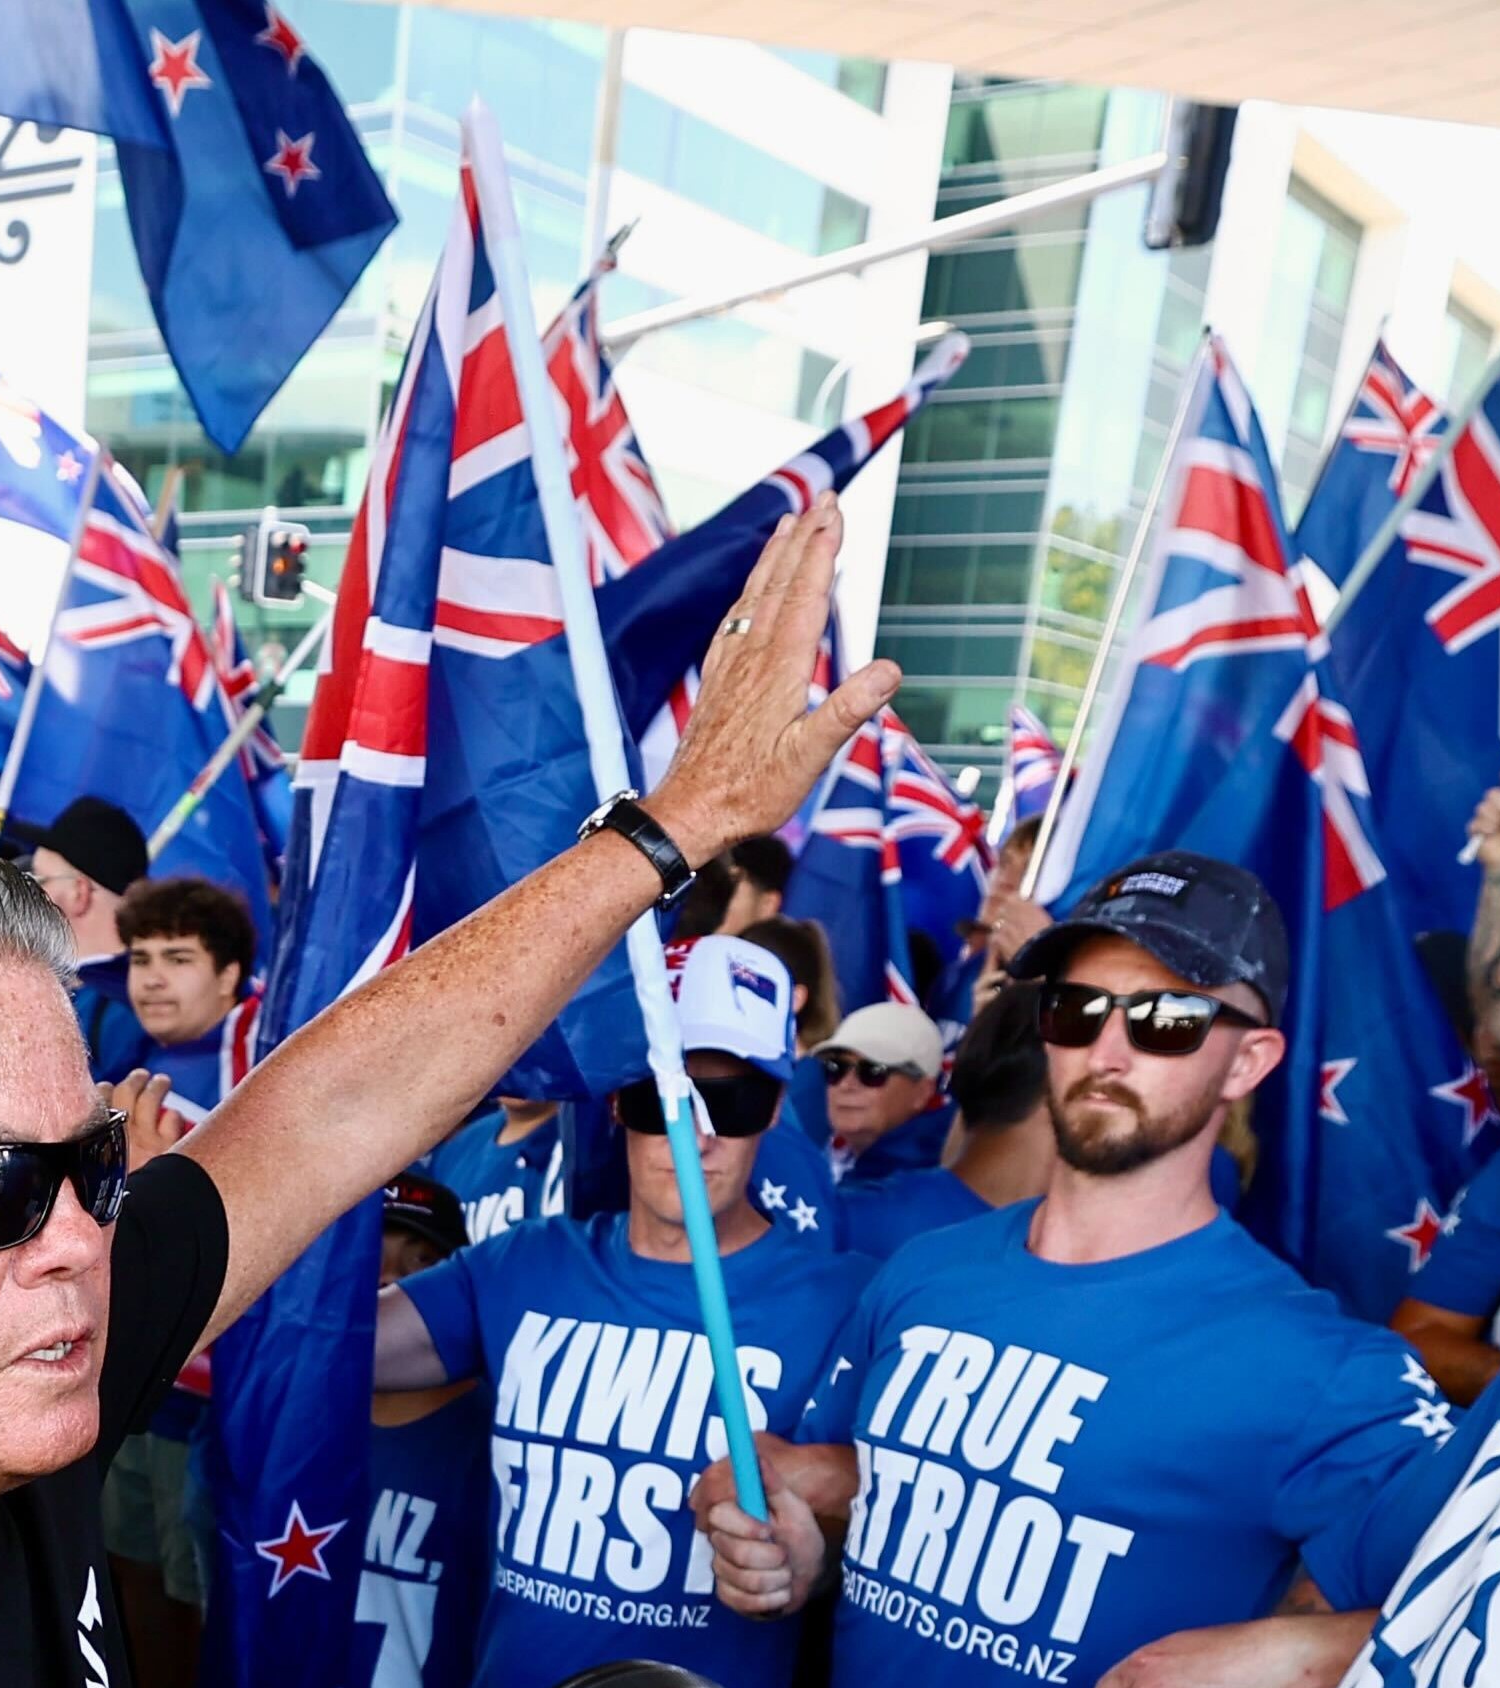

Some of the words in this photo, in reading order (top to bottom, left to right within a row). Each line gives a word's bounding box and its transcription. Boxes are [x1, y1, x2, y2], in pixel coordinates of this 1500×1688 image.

[494, 1310, 783, 1462] KIWIS
[867, 1324, 1109, 1494] TRUE
[491, 1434, 714, 1594] FIRS
